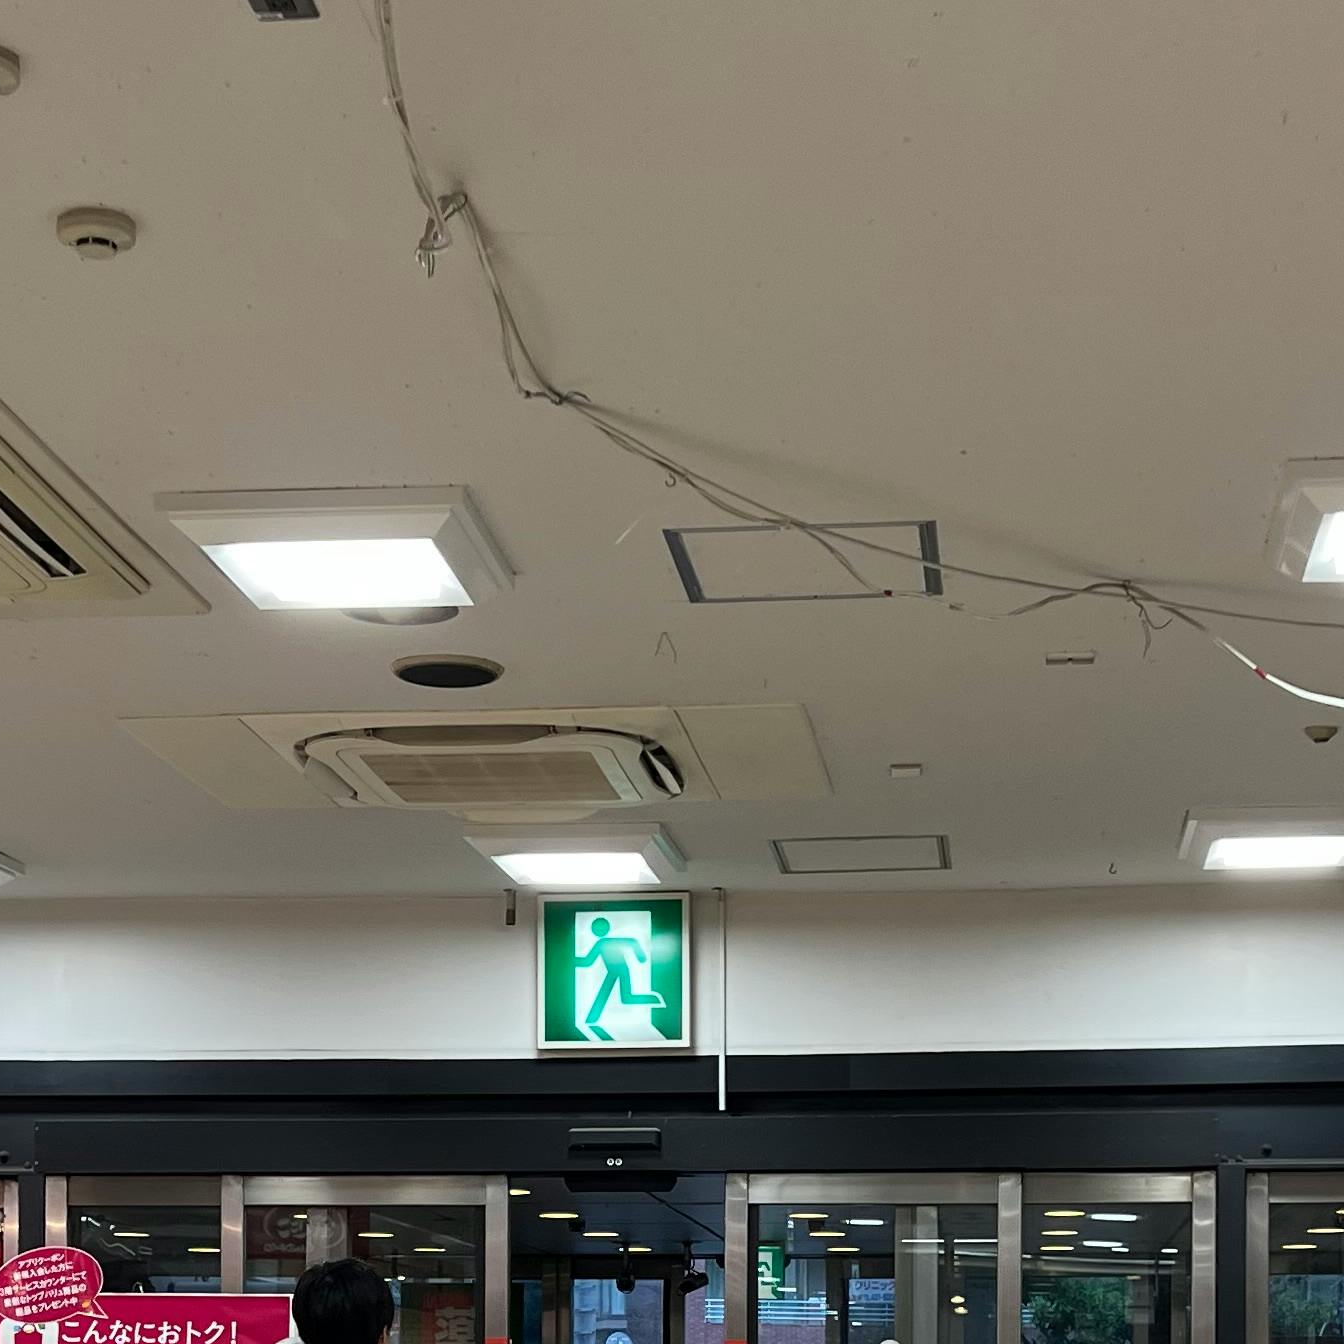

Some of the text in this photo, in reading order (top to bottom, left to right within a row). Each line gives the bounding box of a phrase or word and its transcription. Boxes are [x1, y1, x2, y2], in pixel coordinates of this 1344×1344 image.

[60, 1320, 238, 1344] こんなにおトク!
